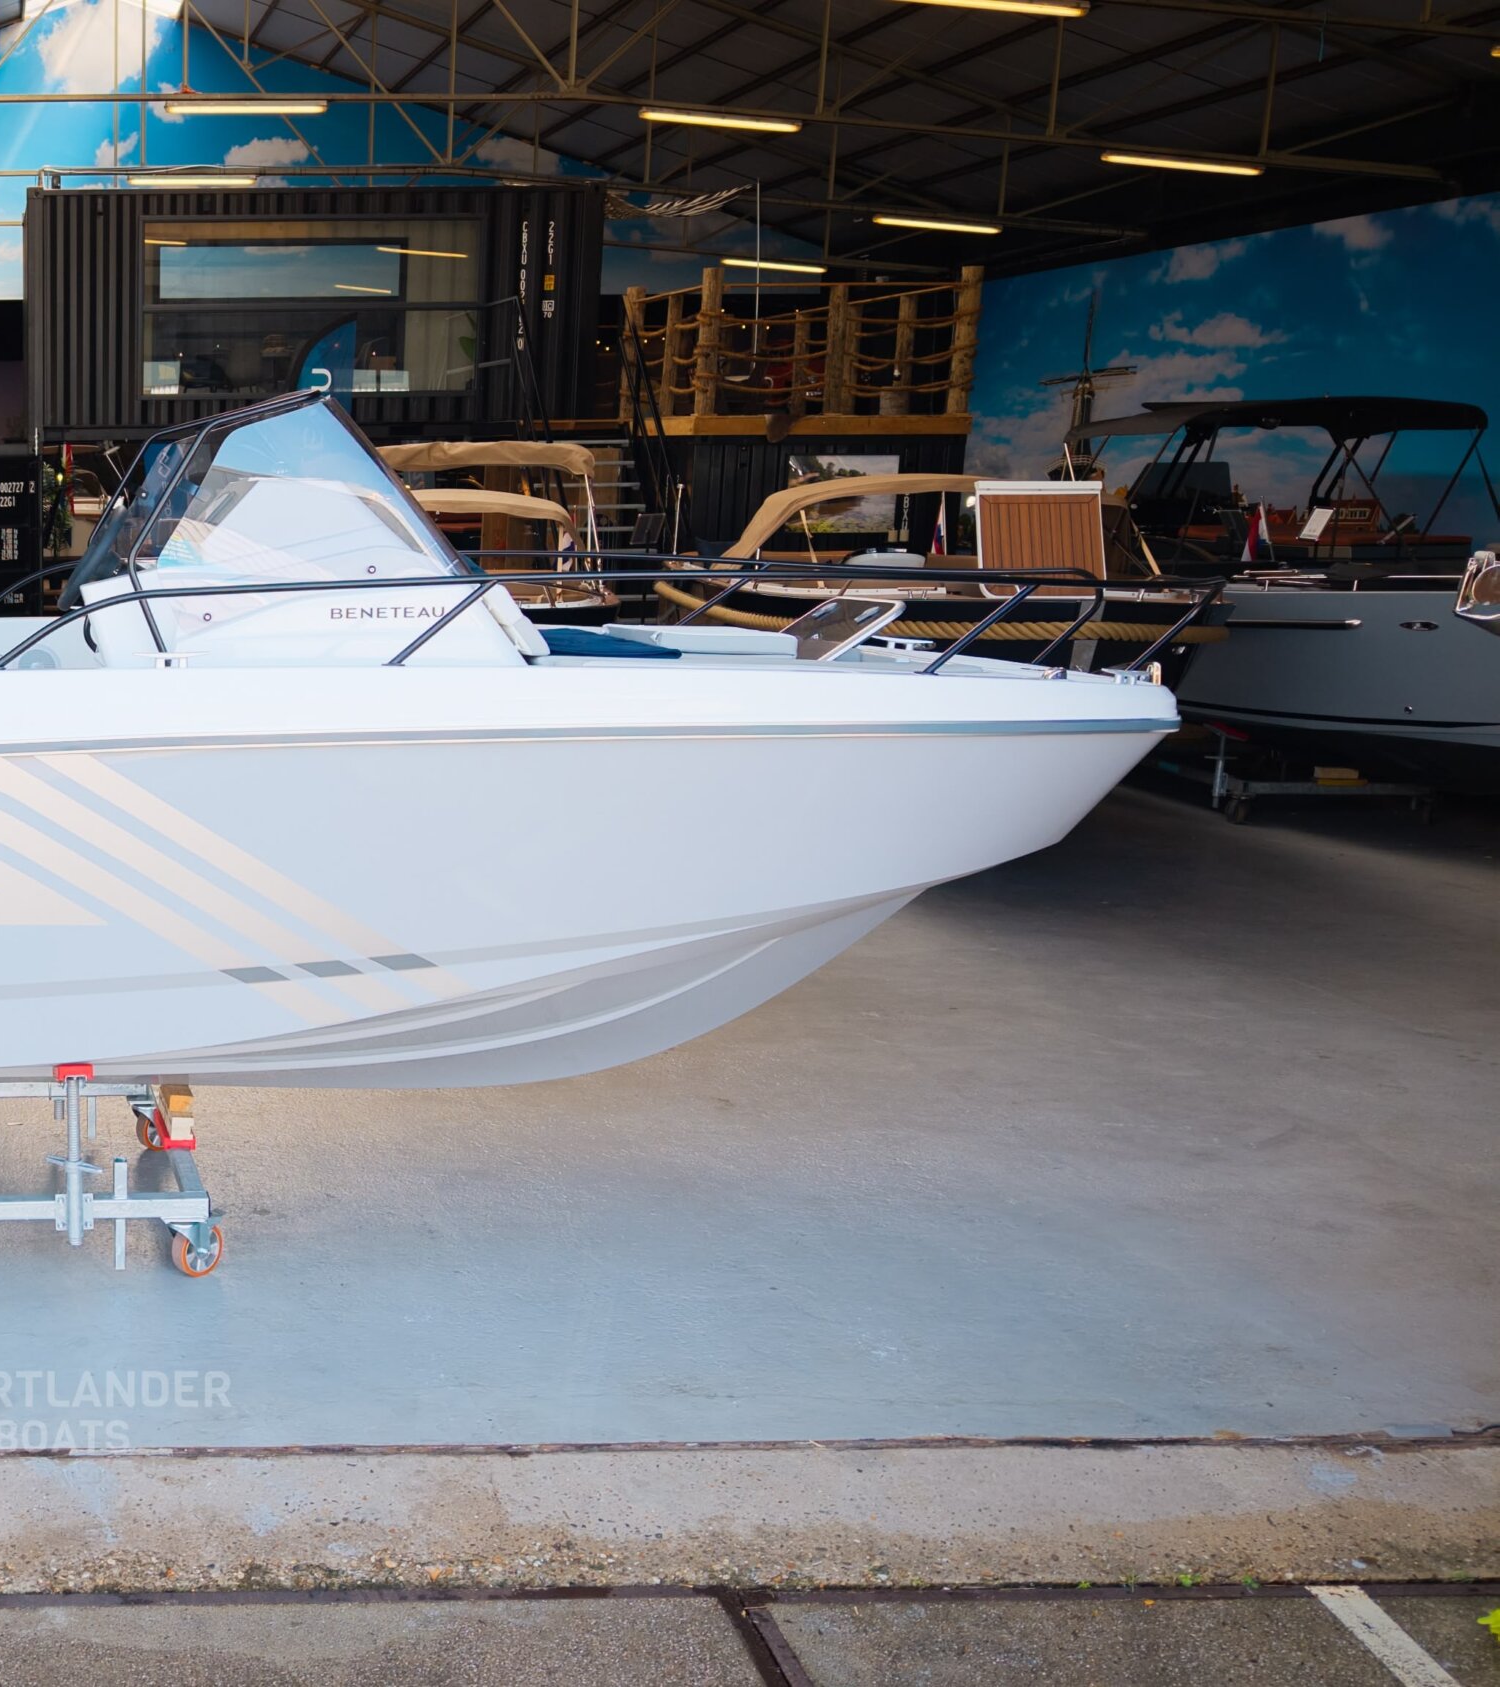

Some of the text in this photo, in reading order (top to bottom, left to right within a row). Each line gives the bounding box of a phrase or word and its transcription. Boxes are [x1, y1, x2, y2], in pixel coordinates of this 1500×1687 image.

[547, 221, 555, 265] 22G1
[0, 482, 24, 493] 002727
[28, 481, 35, 493] 2
[0, 496, 15, 507] 22G1
[330, 606, 445, 619] BENETEAU
